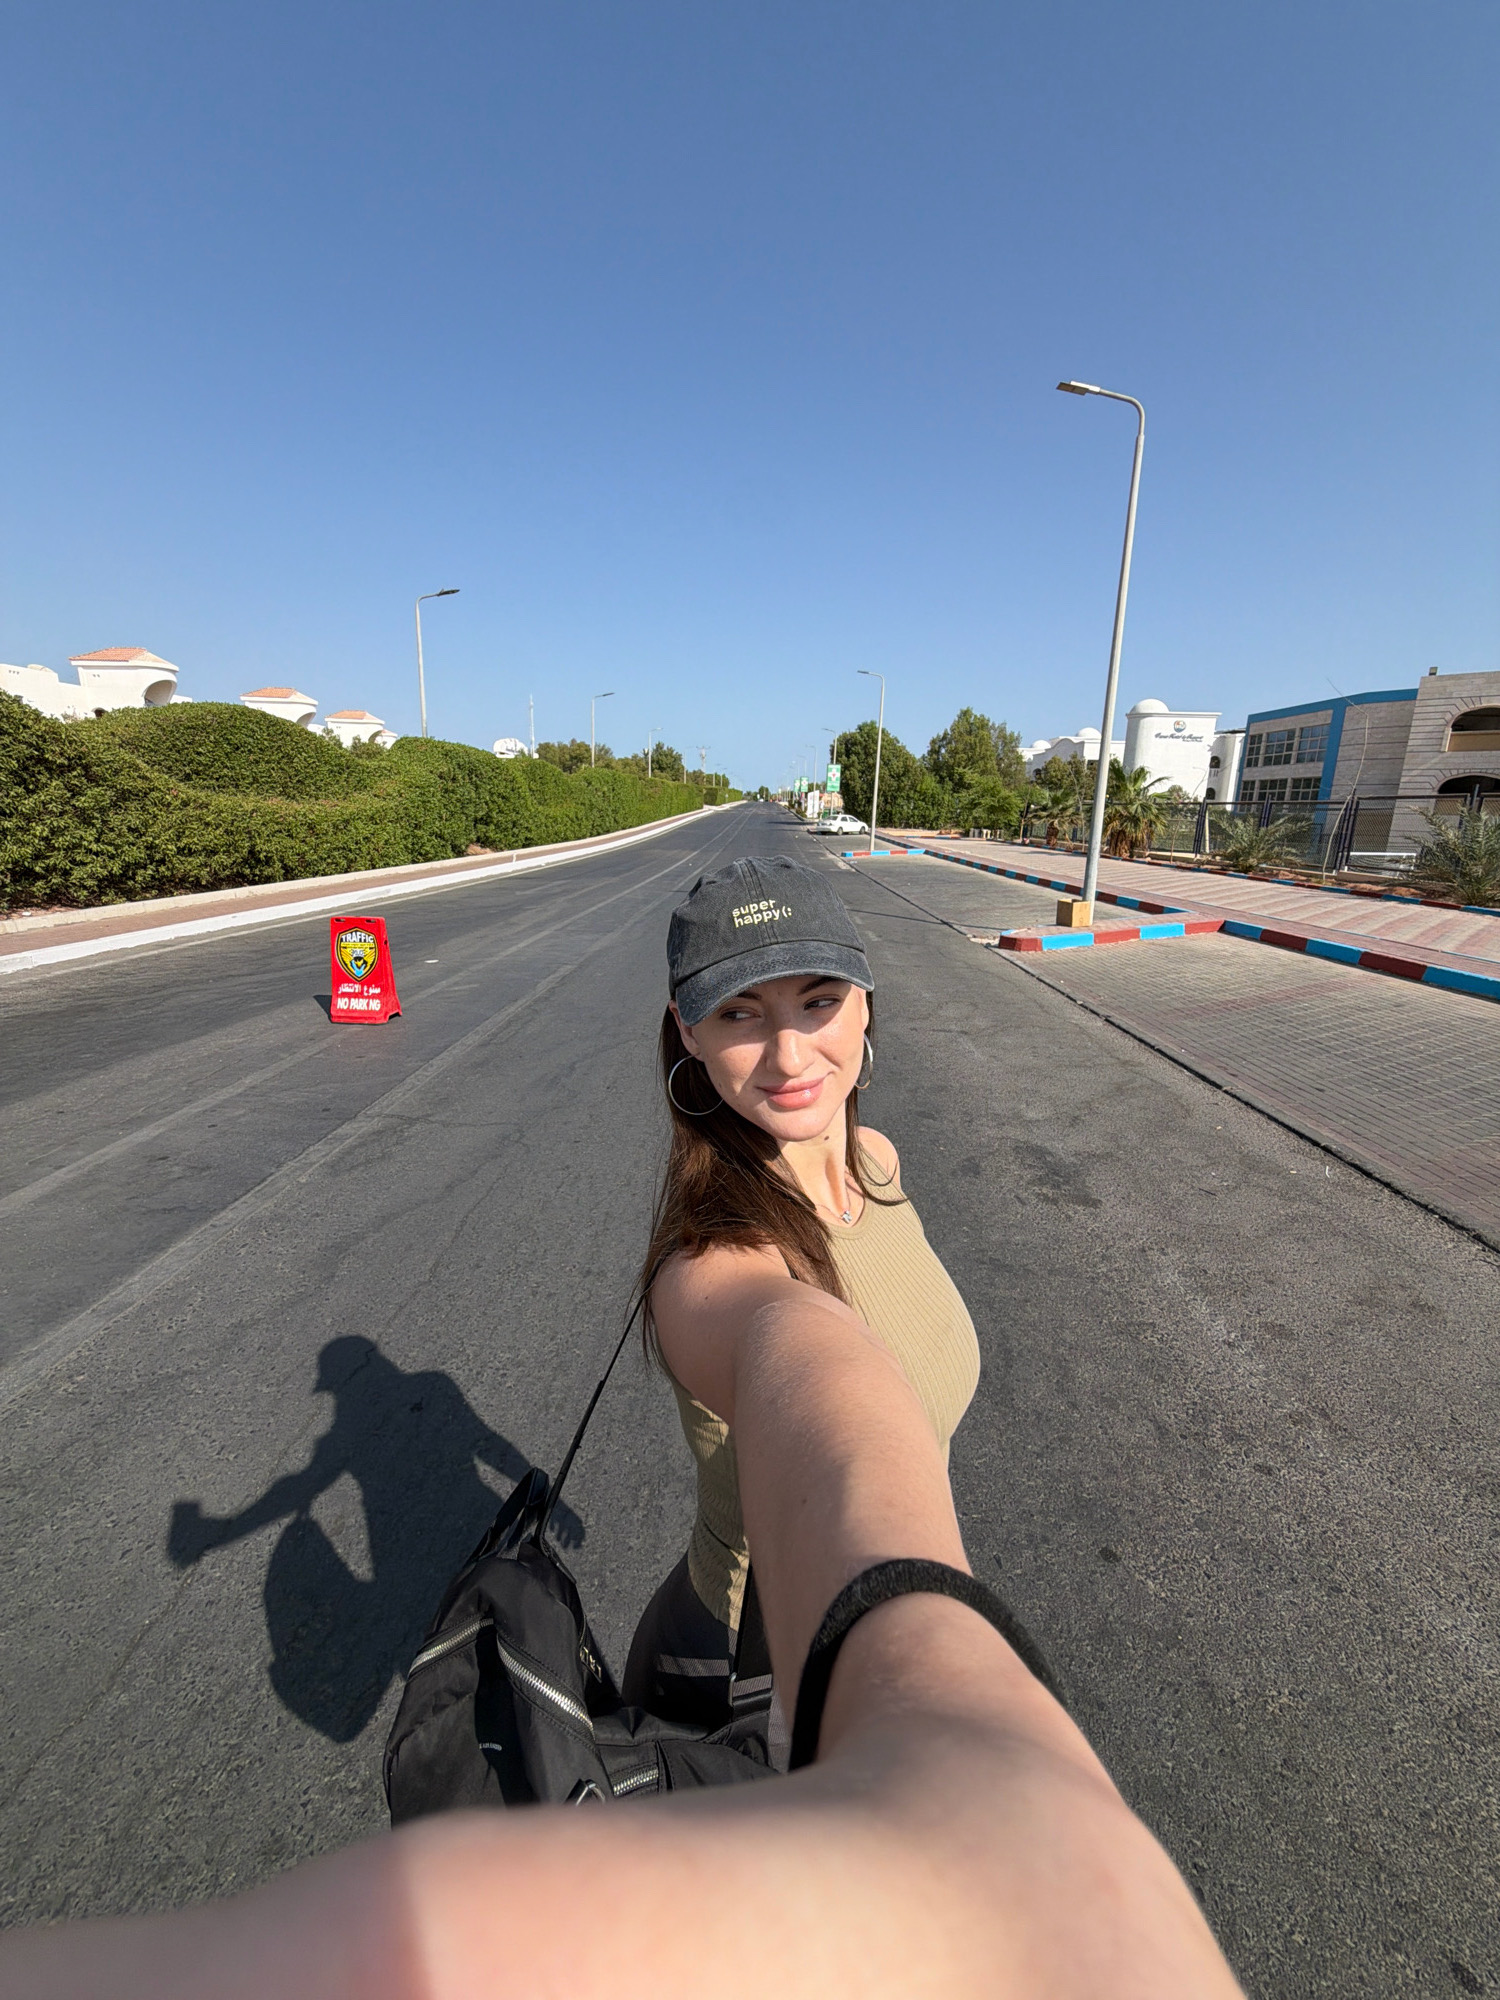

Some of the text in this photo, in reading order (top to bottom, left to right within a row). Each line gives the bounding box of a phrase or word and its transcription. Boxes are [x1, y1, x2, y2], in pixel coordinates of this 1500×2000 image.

[732, 900, 776, 917] super
[341, 932, 374, 943] TRAFFIC
[337, 997, 381, 1011] NO PARKNG
